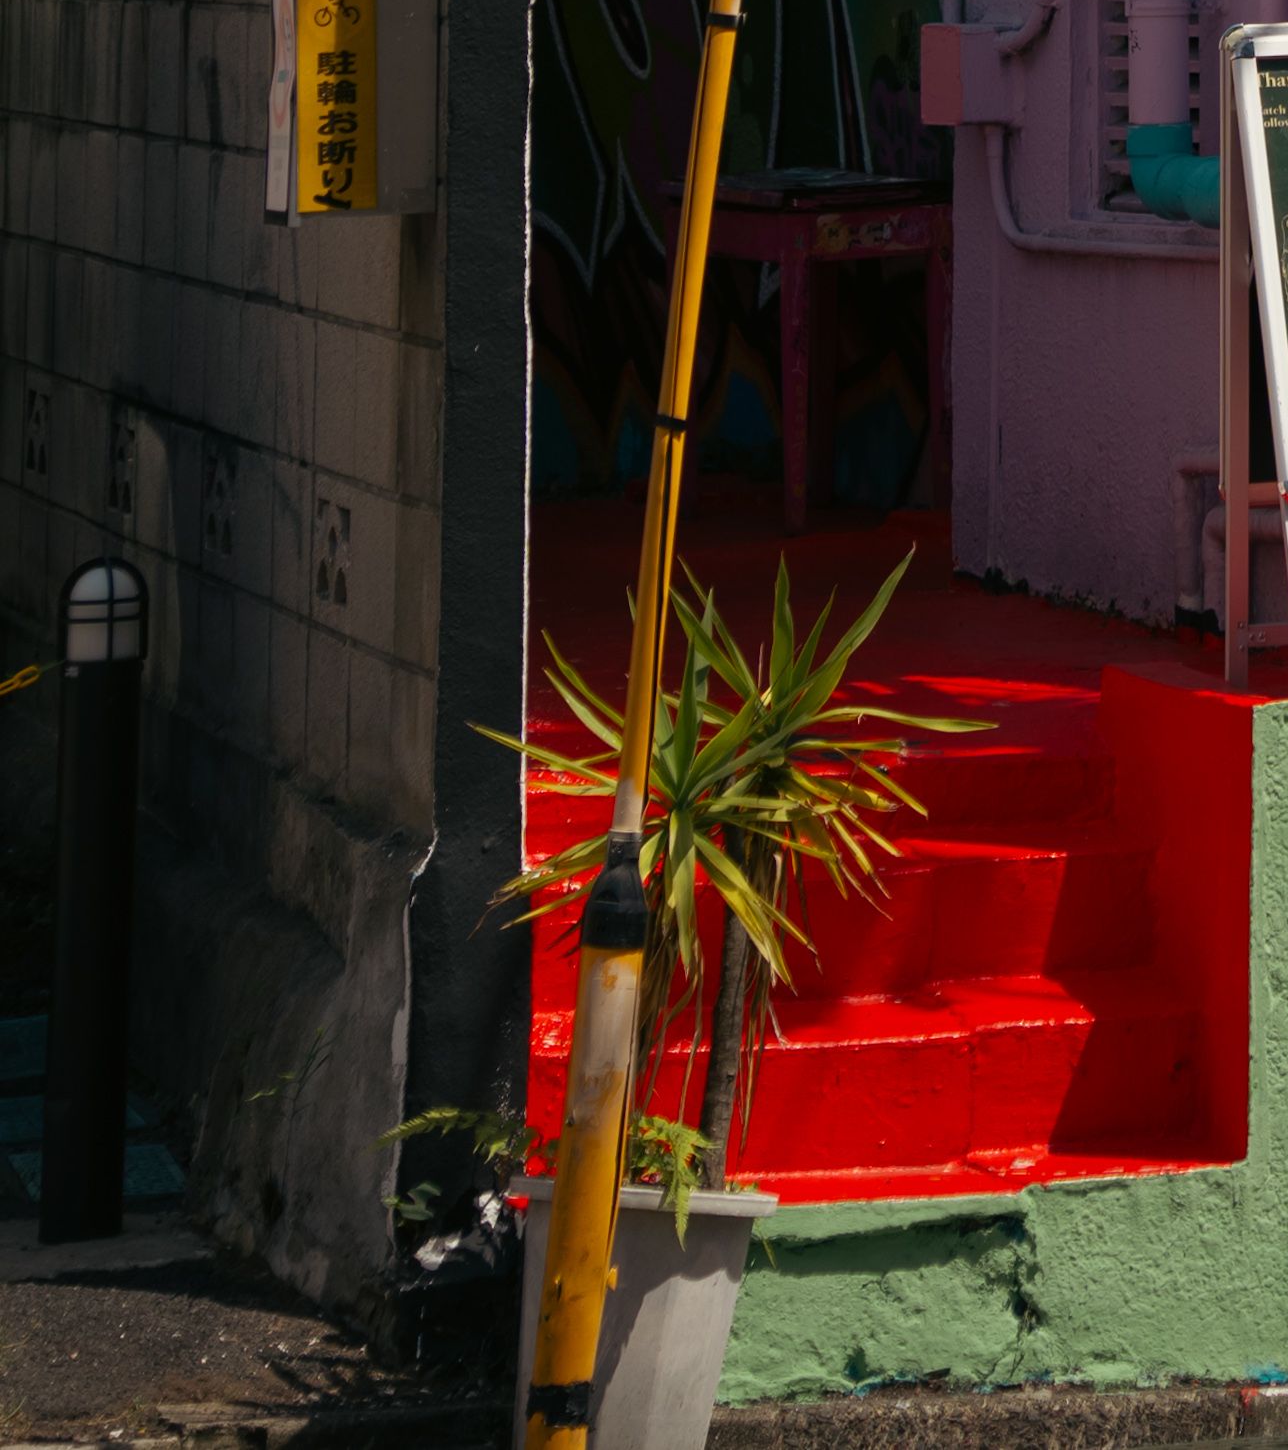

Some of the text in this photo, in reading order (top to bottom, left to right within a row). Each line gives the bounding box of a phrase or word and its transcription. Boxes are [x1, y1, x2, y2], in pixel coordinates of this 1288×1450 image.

[315, 49, 358, 195] 駐輪お断り
[1261, 102, 1287, 116] atch
